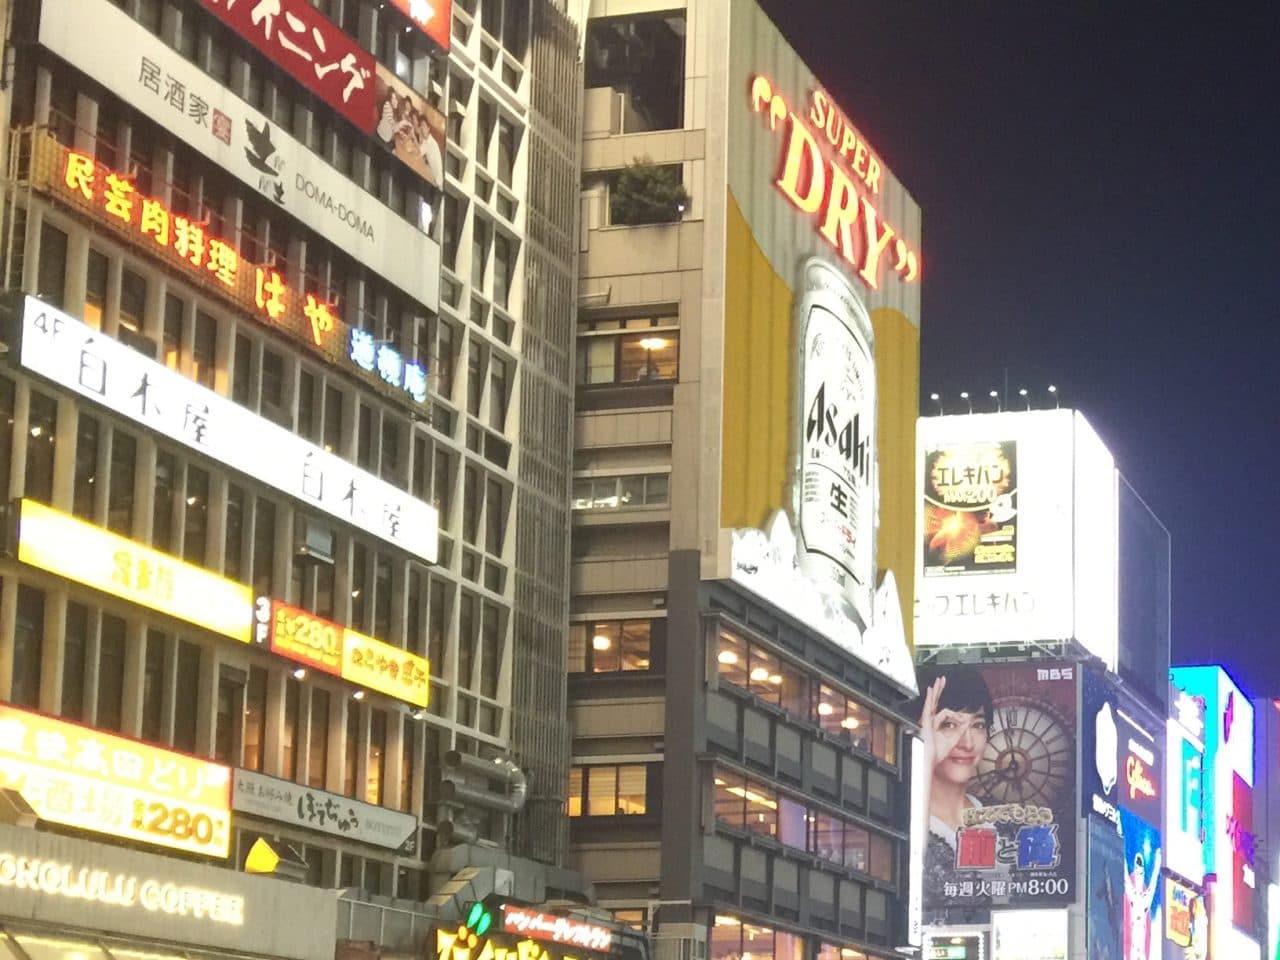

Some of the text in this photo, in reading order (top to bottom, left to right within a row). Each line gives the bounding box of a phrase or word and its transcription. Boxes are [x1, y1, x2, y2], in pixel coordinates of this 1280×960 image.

[139, 55, 209, 129] 居酒家
[211, 0, 371, 103] イニング
[811, 89, 882, 196] SUPER
[66, 153, 240, 288] 民芸肉料理
[255, 269, 334, 346] はや
[295, 173, 376, 243] DOMA-DOMA
[78, 337, 210, 446] 白木屋
[806, 381, 870, 487] Asahi
[1037, 668, 1073, 681] MBS
[140, 879, 245, 925] COFFEE
